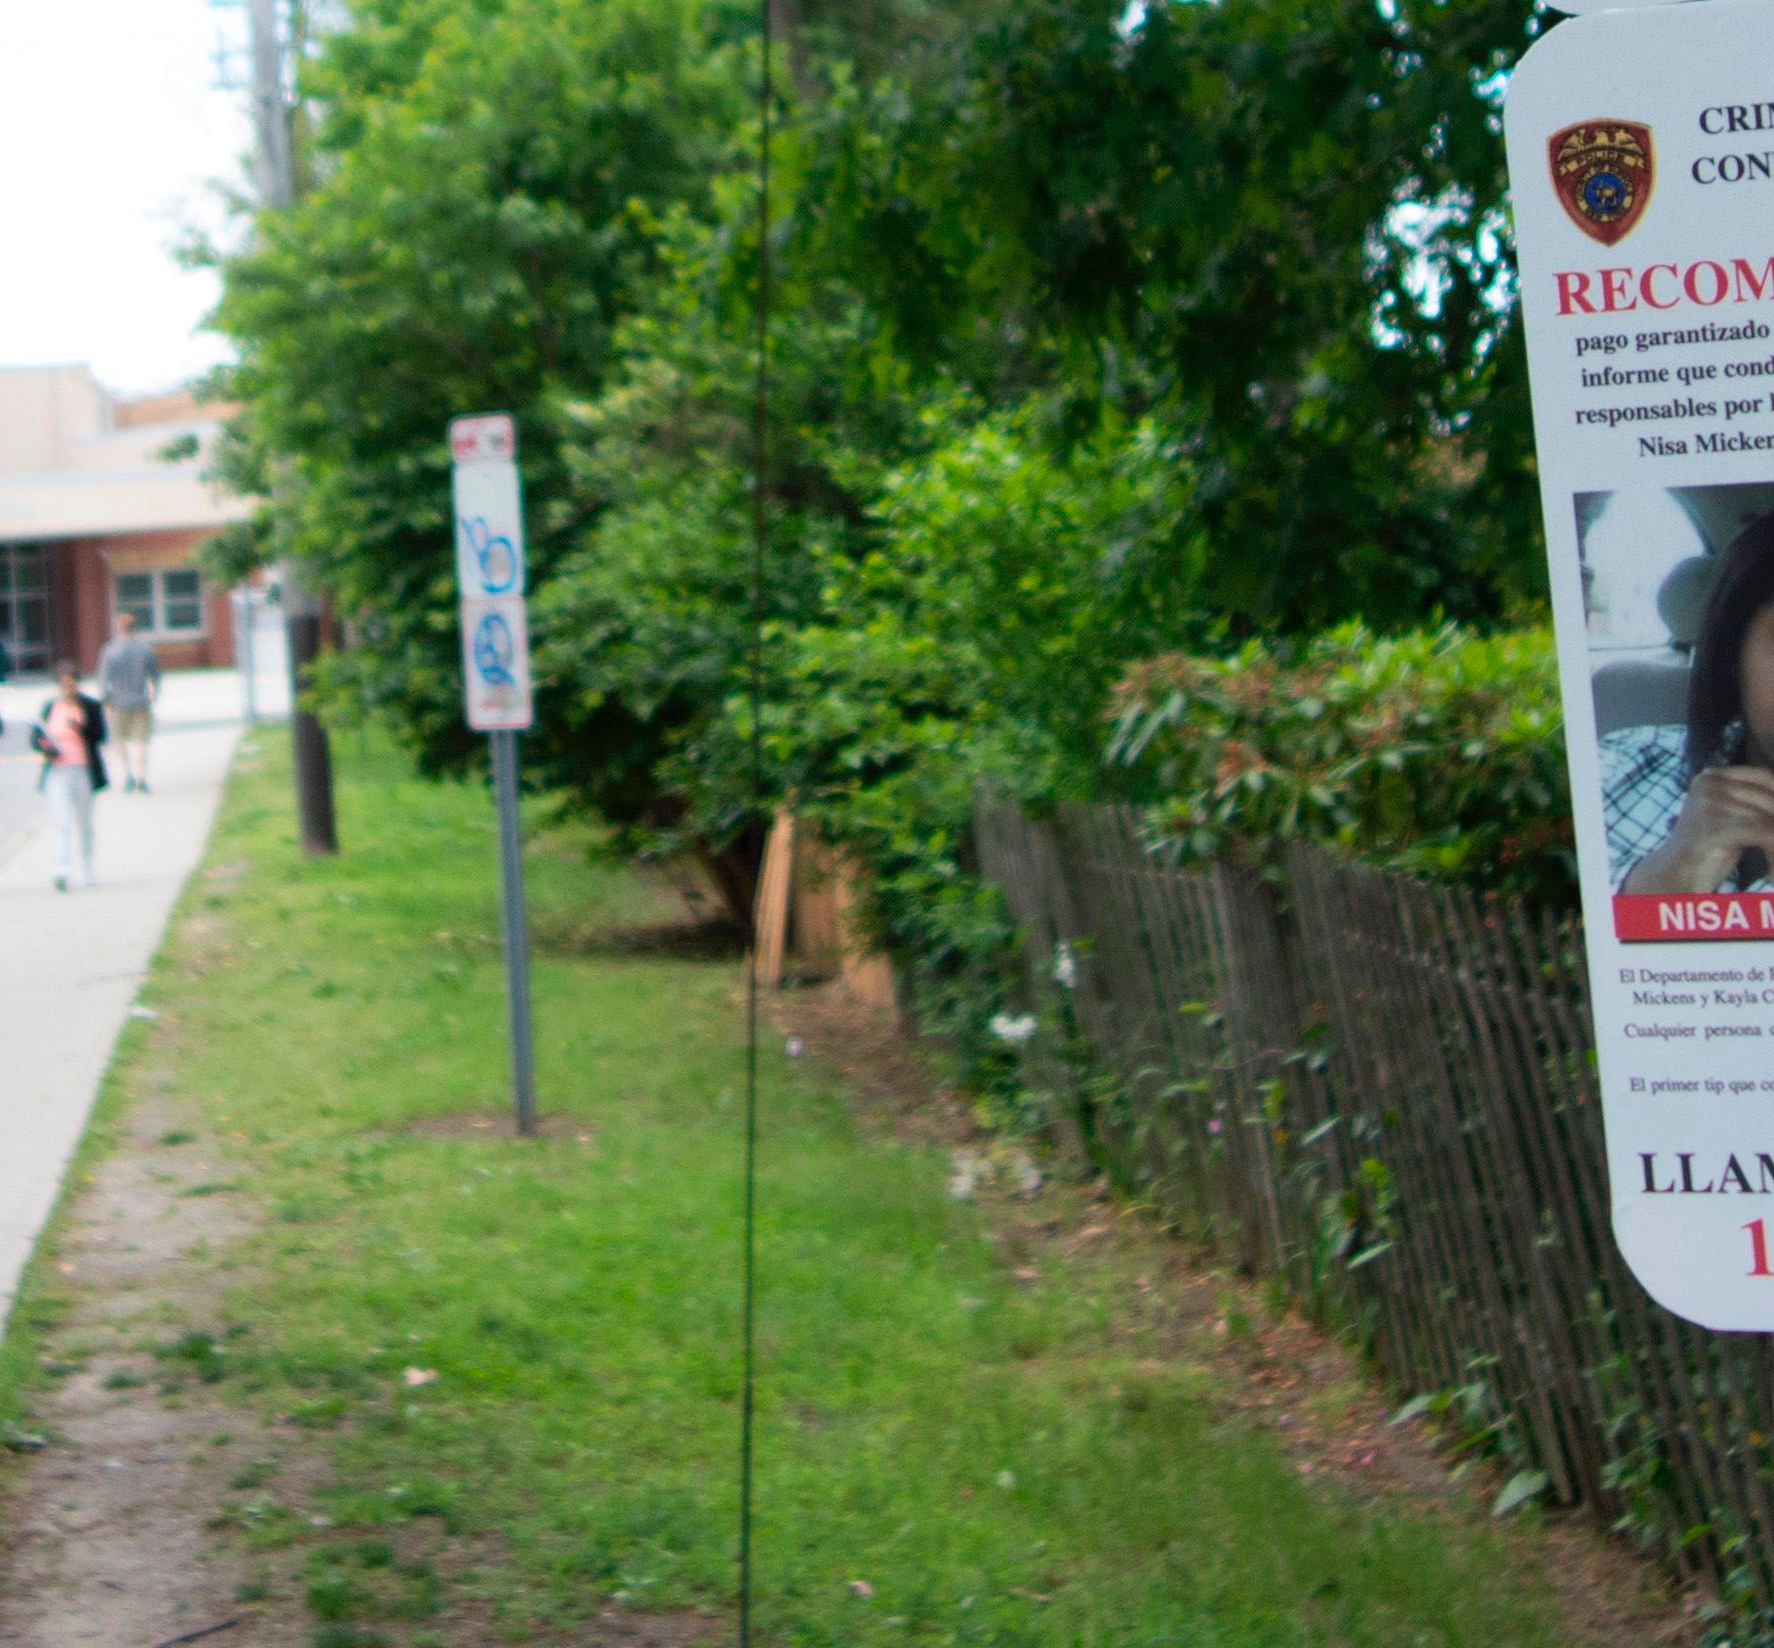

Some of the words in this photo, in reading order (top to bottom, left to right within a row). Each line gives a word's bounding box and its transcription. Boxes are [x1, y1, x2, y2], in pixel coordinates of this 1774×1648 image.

[1575, 334, 1629, 357] pago
[1635, 319, 1770, 352] garantizado
[1581, 366, 1669, 387] informe
[1676, 365, 1717, 386] que
[1575, 397, 1717, 427] responsables
[1724, 398, 1763, 420] por
[1638, 436, 1688, 456] Nisa
[1658, 900, 1749, 931] NISA
